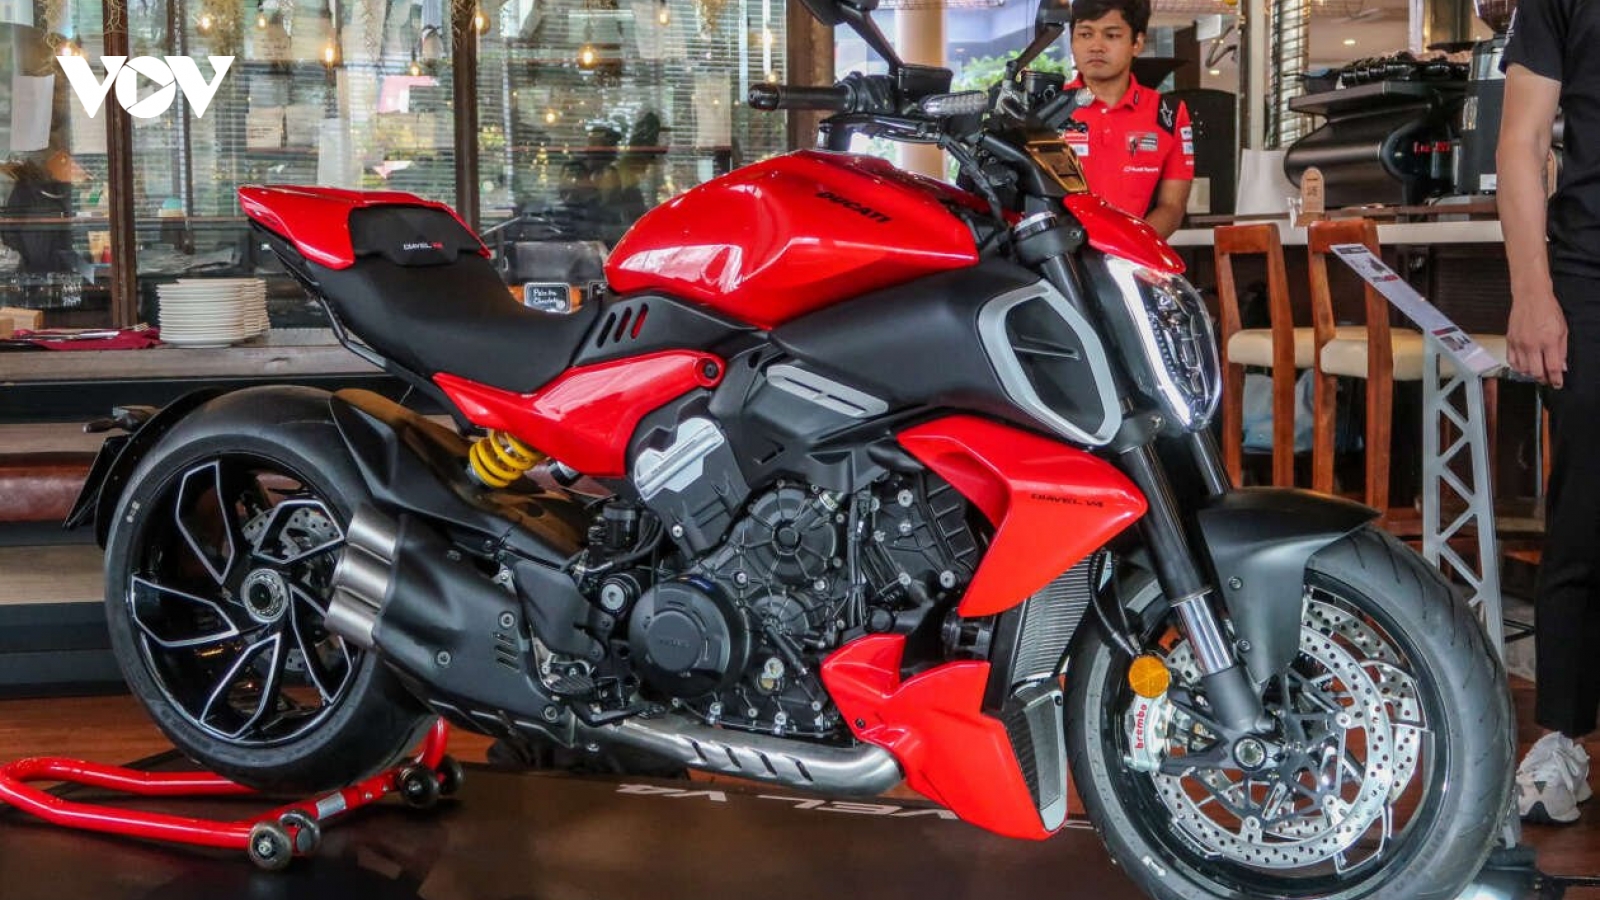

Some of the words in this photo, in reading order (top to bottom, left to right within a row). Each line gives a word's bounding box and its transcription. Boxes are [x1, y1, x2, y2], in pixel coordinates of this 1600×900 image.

[815, 191, 892, 223] DUCATI
[1030, 493, 1082, 506] DIAVEL
[1134, 703, 1148, 749] brembo
